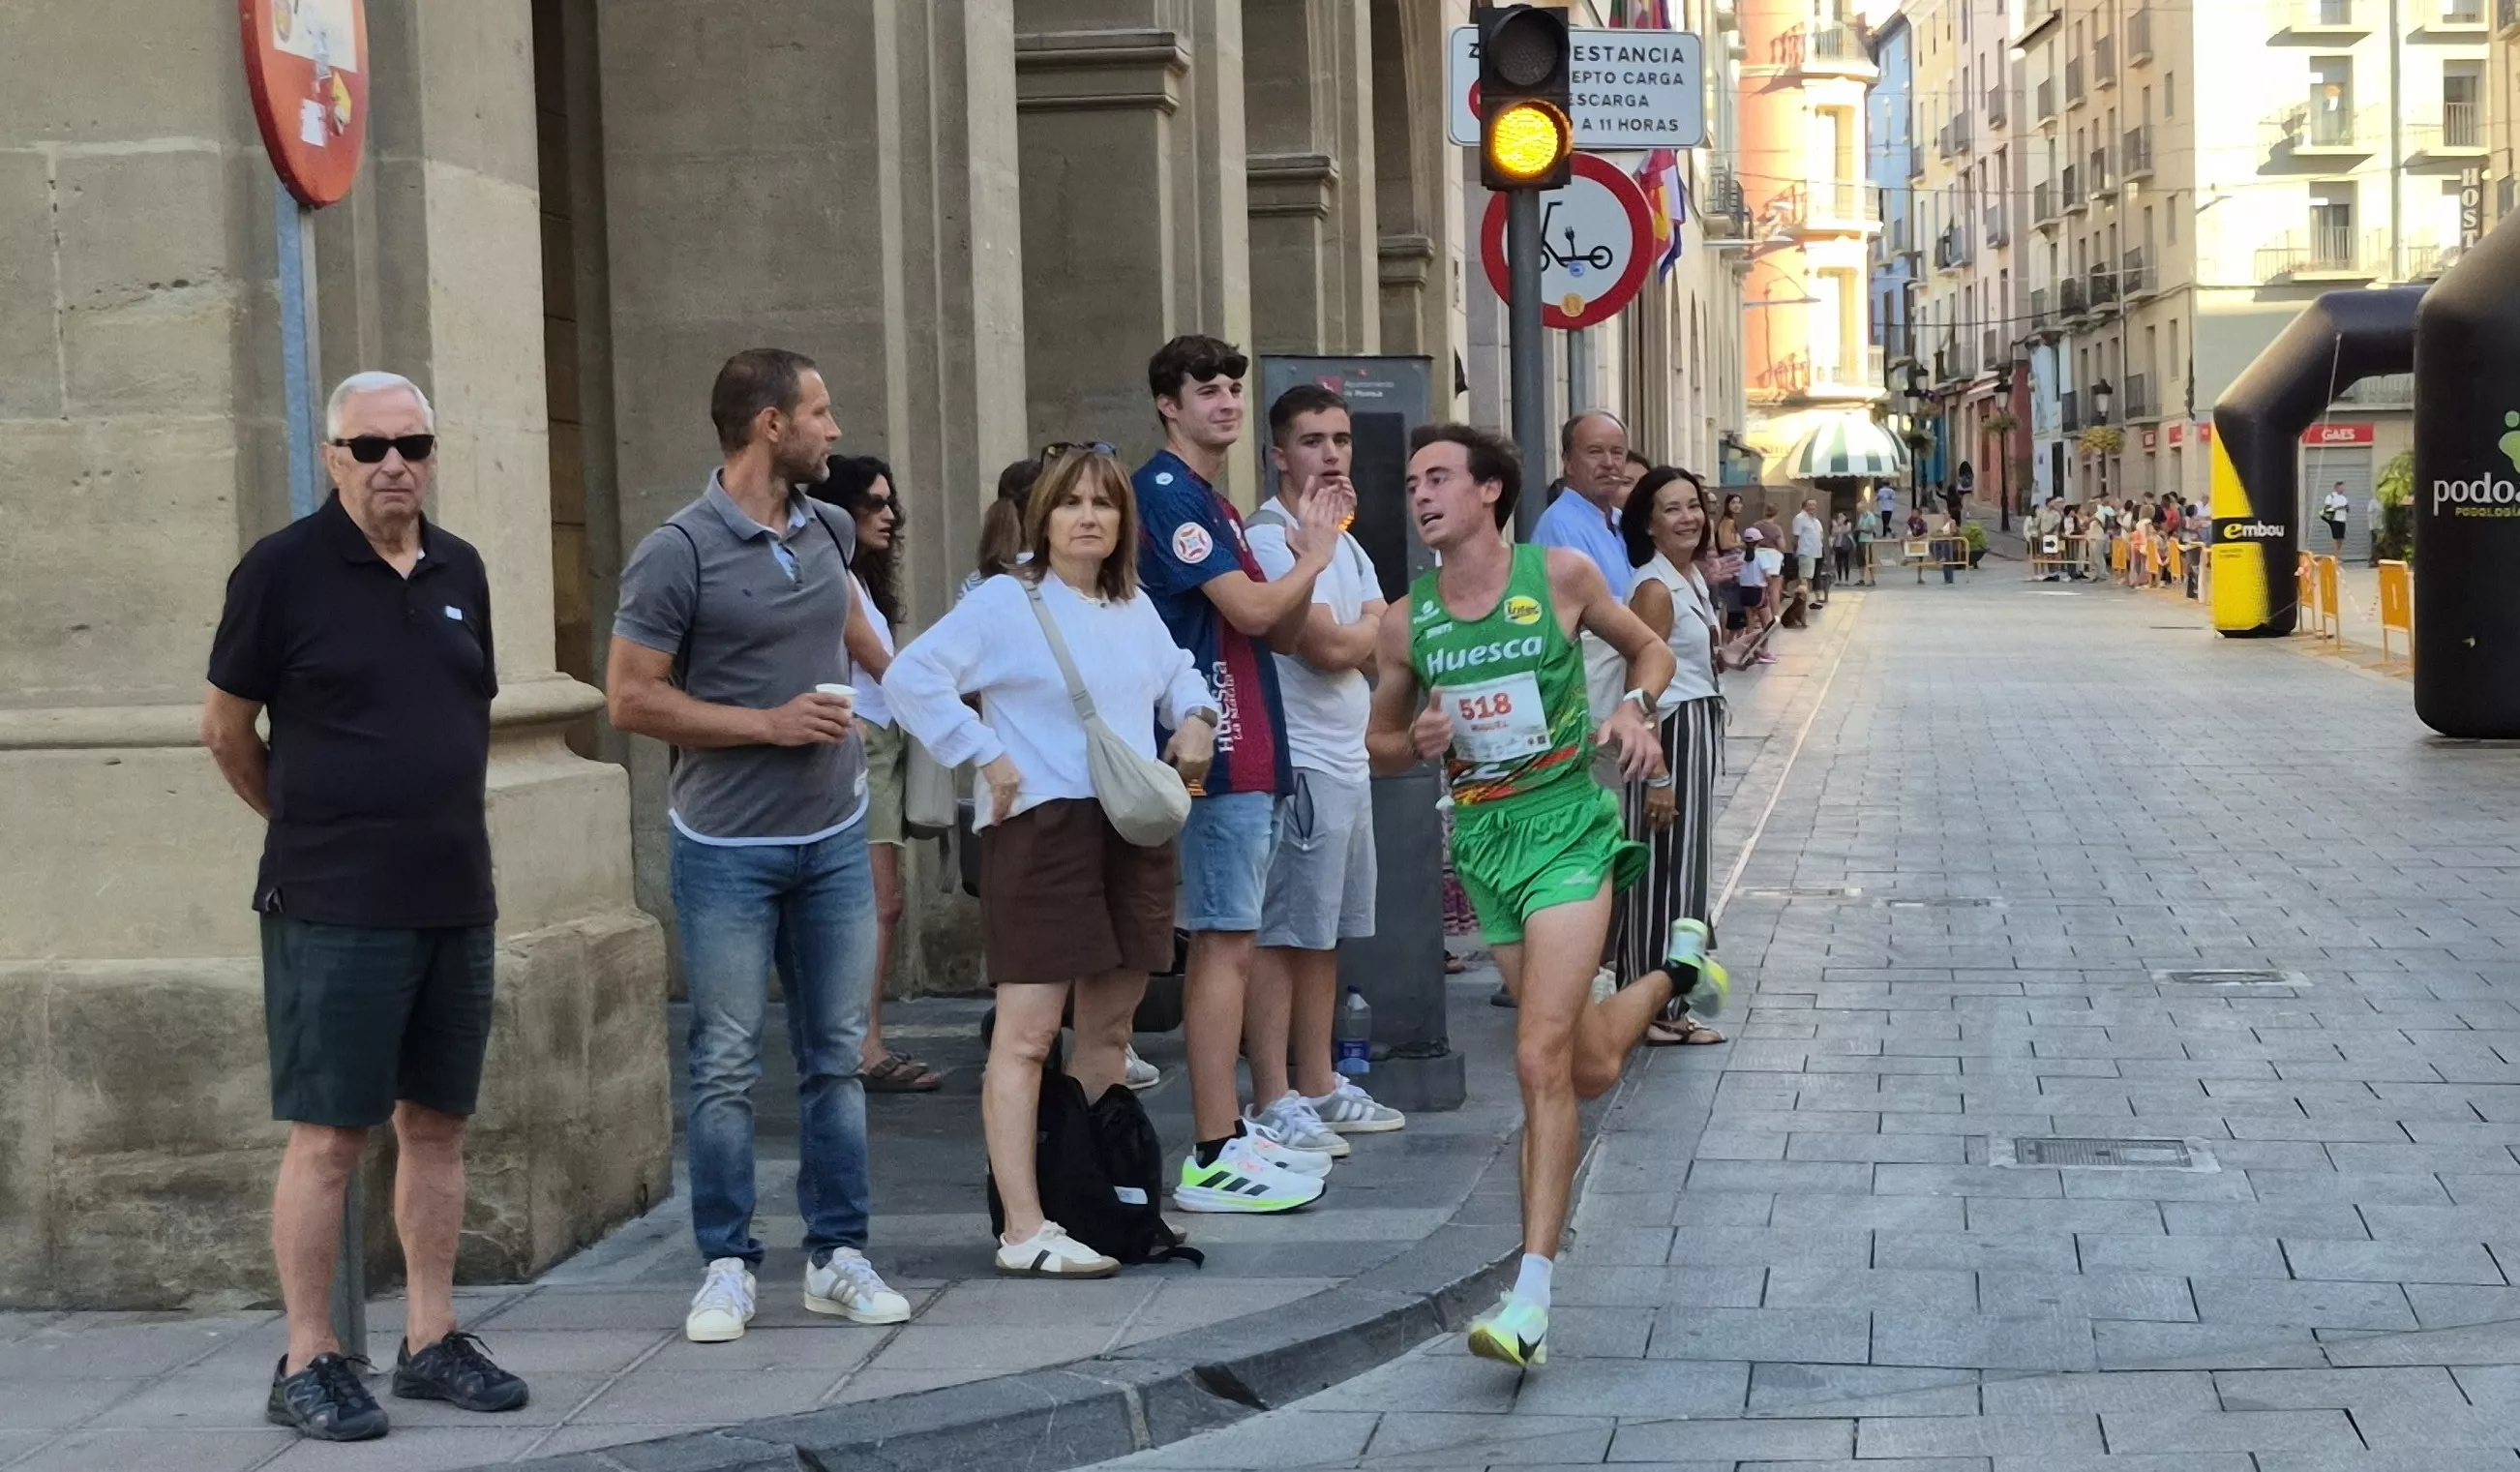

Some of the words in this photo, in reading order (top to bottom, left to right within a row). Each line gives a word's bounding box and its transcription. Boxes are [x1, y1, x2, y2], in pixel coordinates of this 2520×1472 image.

[1574, 45, 1685, 64] ESTANCIA
[1572, 70, 1616, 85] EPTO
[1623, 72, 1685, 86] CARGA
[1569, 93, 1649, 107] ESCARGA
[1581, 118, 1592, 131] A
[1599, 118, 1611, 131] 11
[1618, 118, 1679, 132] HORAS
[2461, 167, 2479, 248] HOST
[2322, 428, 2355, 441] GAES
[2433, 471, 2520, 517] podo
[2223, 520, 2285, 539] embou
[1425, 636, 1543, 678] Huesca
[1212, 661, 1235, 752] Huesca
[1458, 692, 1512, 721] 518
